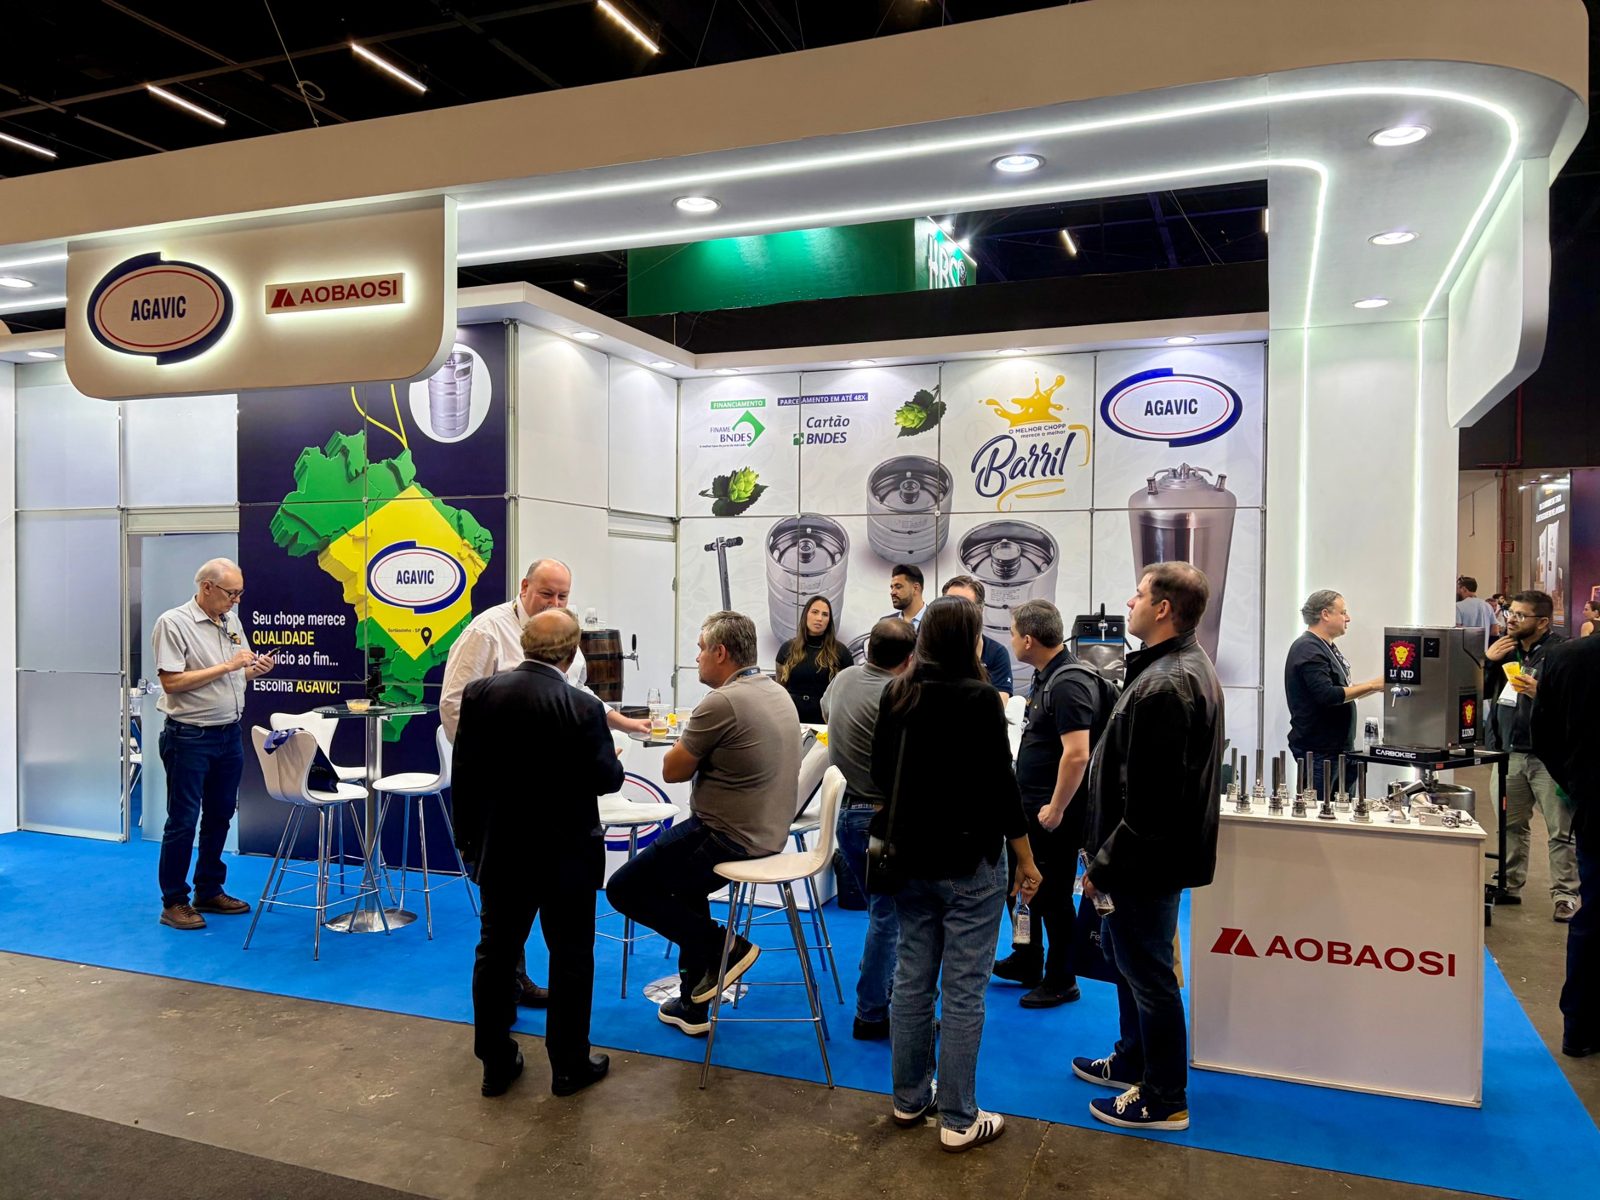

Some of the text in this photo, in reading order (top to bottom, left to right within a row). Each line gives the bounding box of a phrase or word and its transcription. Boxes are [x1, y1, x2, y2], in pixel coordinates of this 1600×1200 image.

[300, 279, 397, 305] AOBAOSI
[130, 295, 187, 322] AGAVIC
[713, 400, 764, 409] FINANCIAMENTO
[841, 393, 853, 402] ATÉ
[1144, 398, 1198, 416] AGAVIC
[806, 415, 850, 429] Cartão
[1044, 423, 1067, 431] CHOPP
[720, 432, 752, 443] BNDES
[806, 432, 847, 445] BNDES
[971, 432, 1077, 498] Barril
[396, 569, 435, 585] AGAVIC
[252, 610, 346, 629] Seu chope merece
[252, 630, 315, 646] QUALIDADE
[268, 650, 296, 665] nício
[297, 653, 311, 666] ao
[313, 651, 339, 666] fim...
[253, 680, 340, 695] Escolha AGAVIC!
[1265, 935, 1456, 977] AOBAOSI
